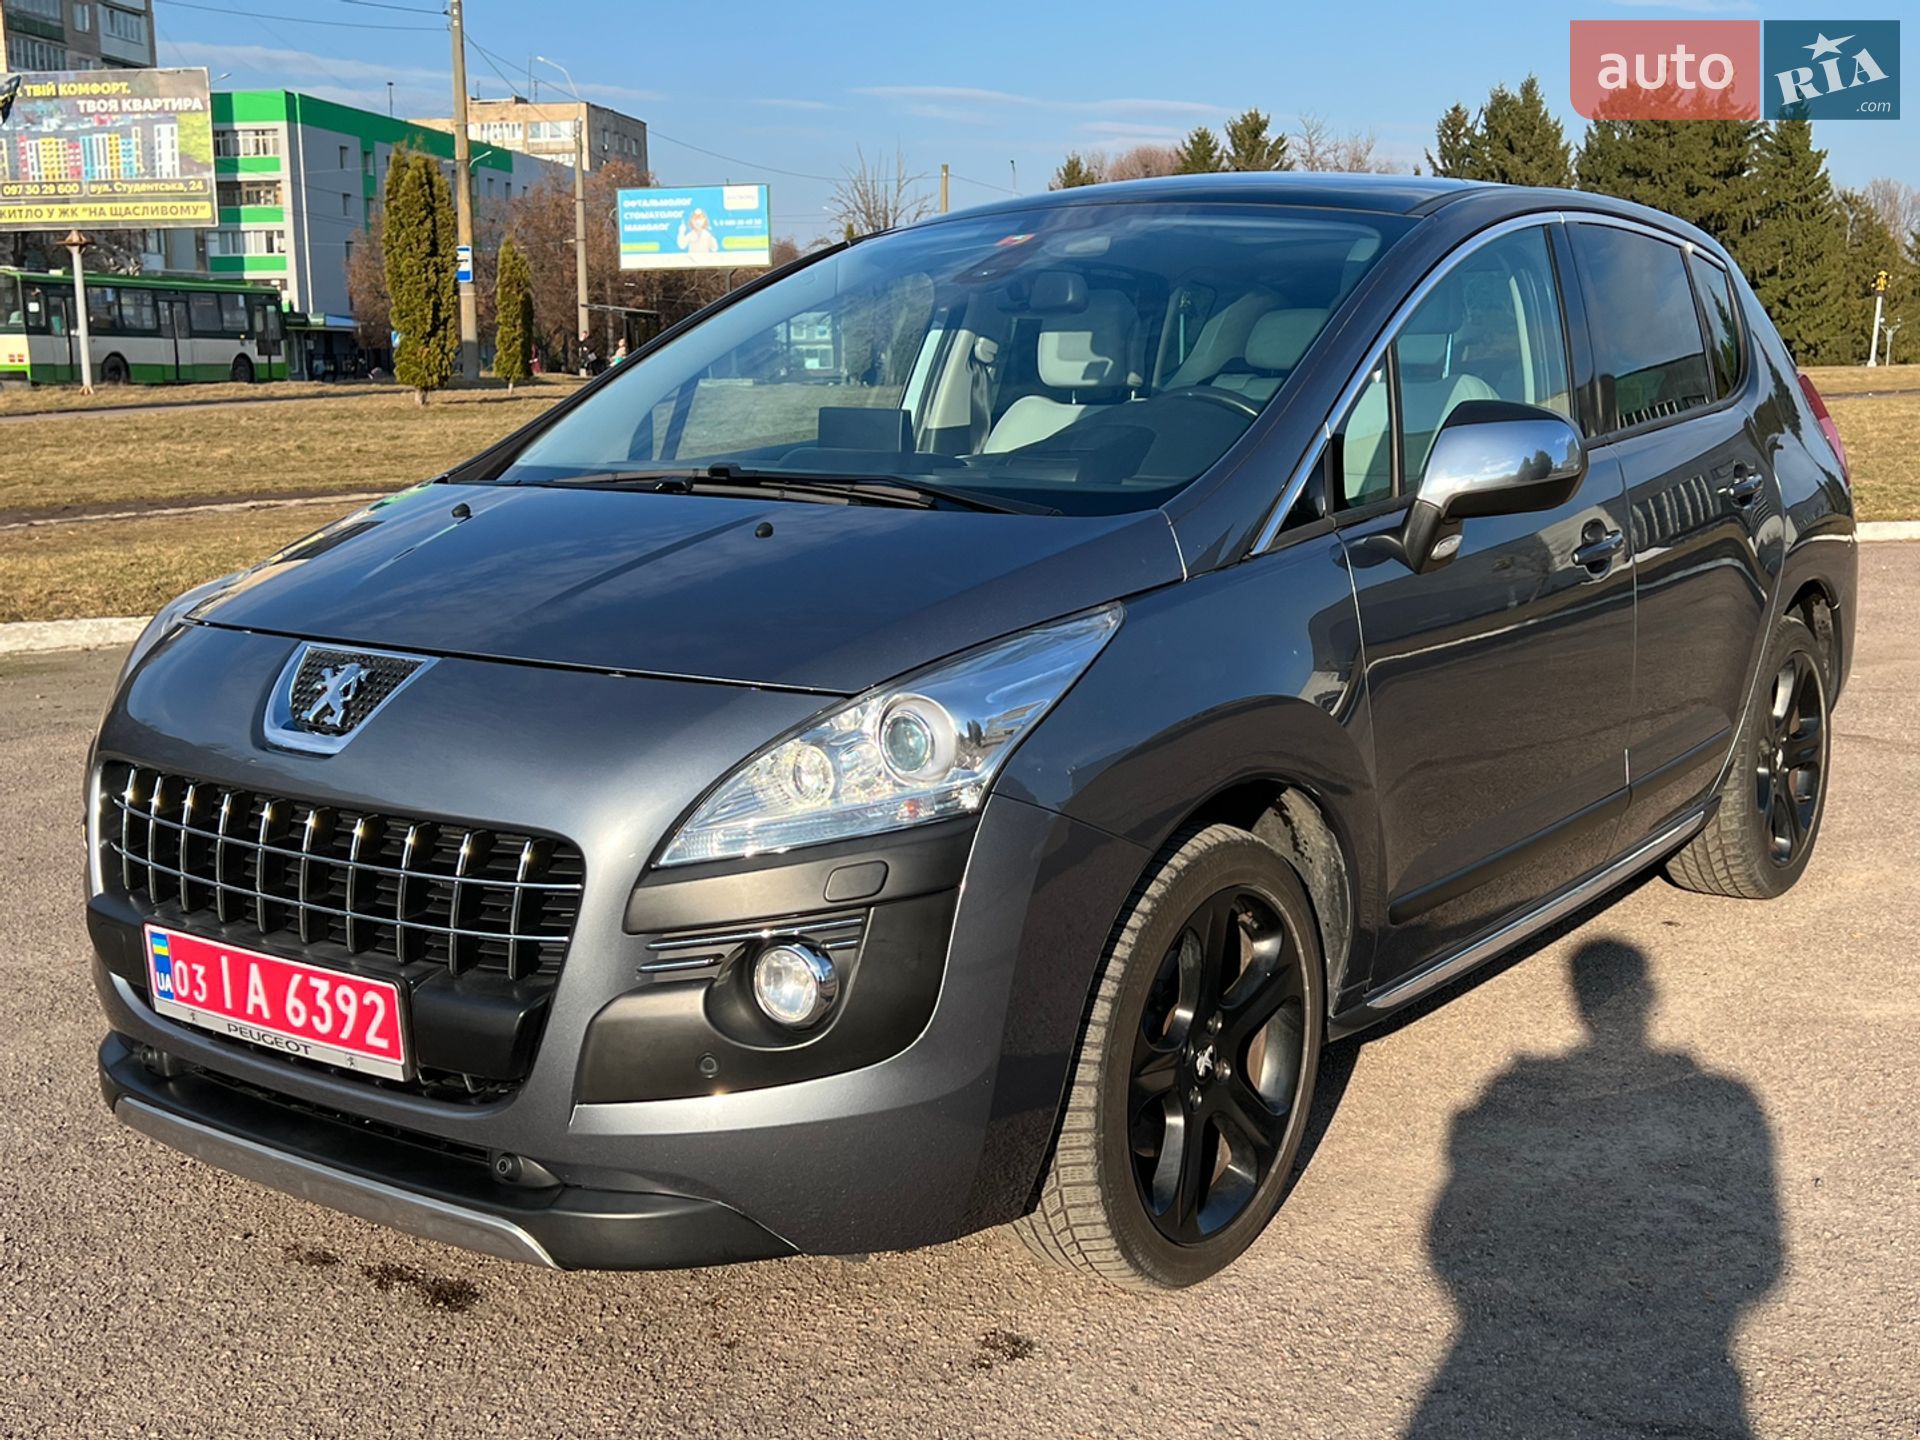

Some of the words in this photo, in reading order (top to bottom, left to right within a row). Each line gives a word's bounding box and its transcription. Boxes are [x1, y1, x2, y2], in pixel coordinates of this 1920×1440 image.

[24, 82, 56, 97] ТВІЙ
[59, 82, 130, 95] КОМФОРТ.
[77, 100, 118, 113] ТВОЯ
[122, 97, 203, 112] КВАРТИРА
[3, 185, 23, 195] 097
[190, 181, 203, 190] 24
[59, 207, 78, 217] ЖК
[157, 972, 174, 992] UA
[174, 960, 207, 1002] 03
[285, 973, 389, 1049] 6392
[227, 1022, 312, 1056] PEUGEOT
